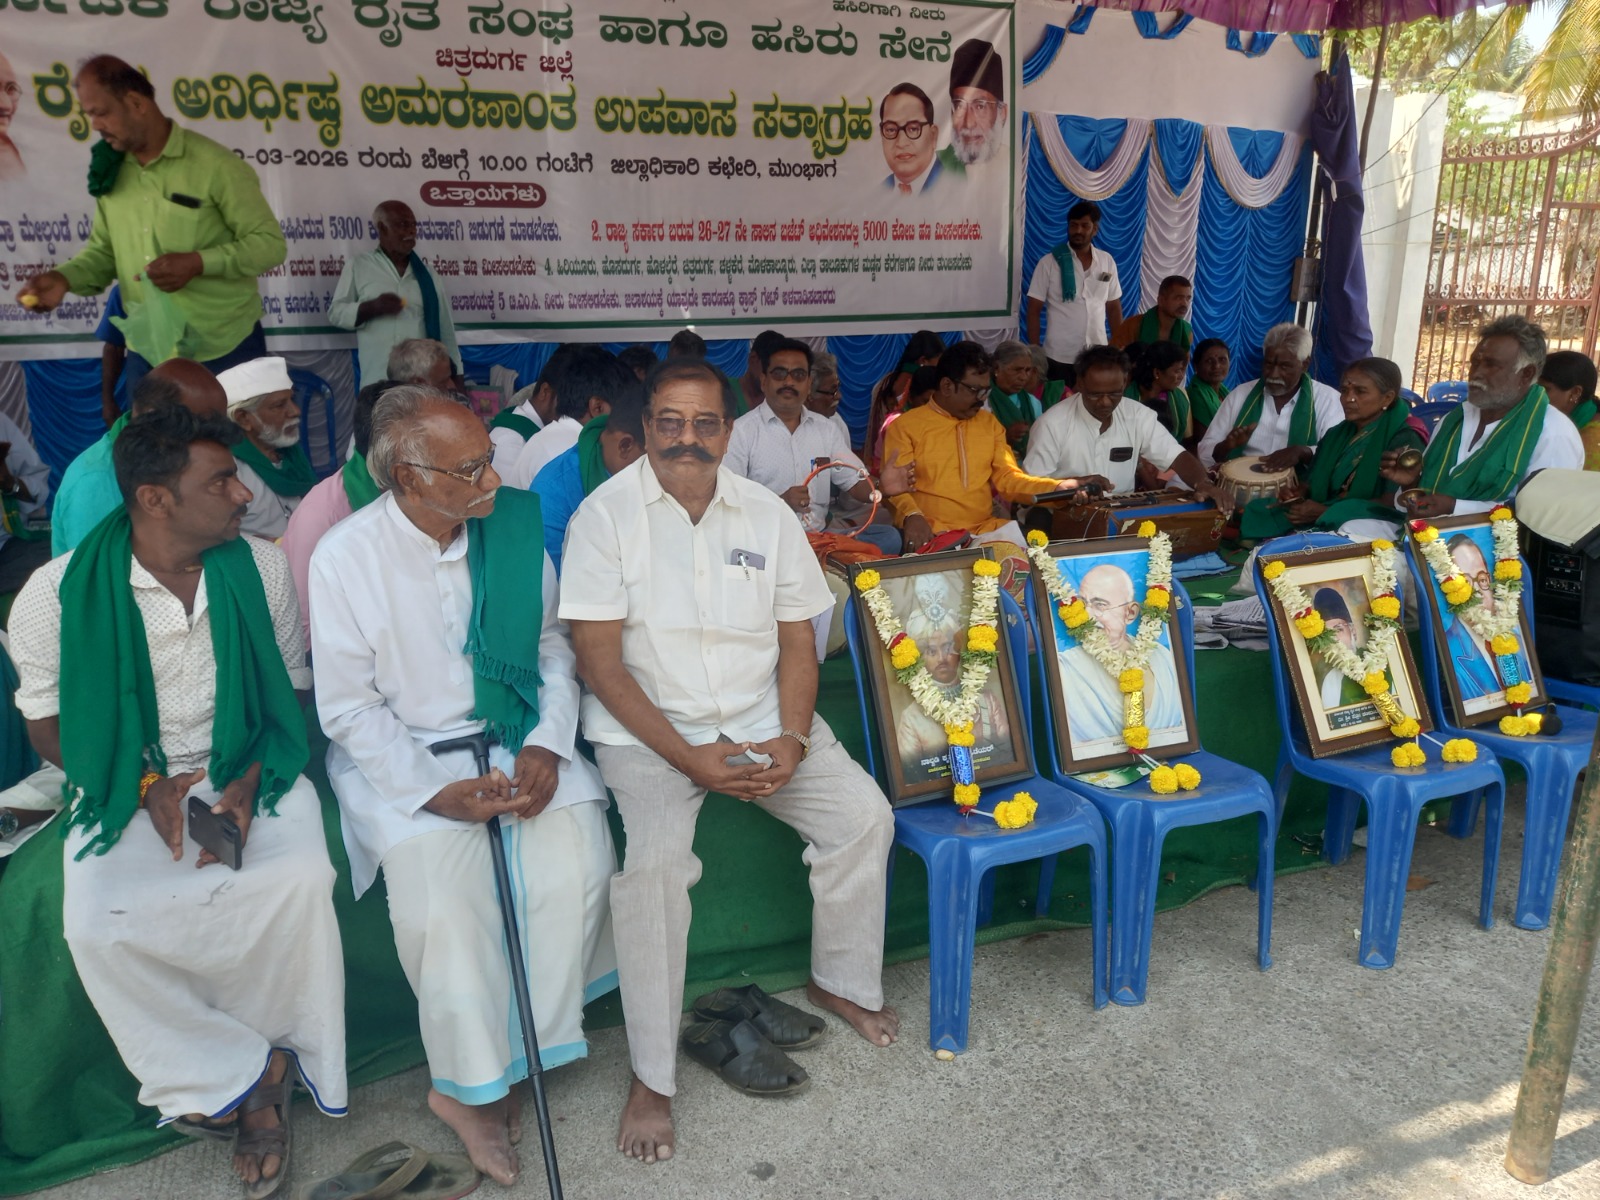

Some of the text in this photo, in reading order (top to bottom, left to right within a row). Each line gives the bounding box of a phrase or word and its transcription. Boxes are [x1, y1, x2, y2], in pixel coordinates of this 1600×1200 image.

[909, 6, 945, 20] ನೀರು
[354, 0, 441, 47] ರೈತ
[469, 2, 573, 45] ಸಂಘ
[599, 11, 728, 48] ಹಾಗೂ
[751, 19, 858, 57] ಹಸಿರು
[879, 26, 952, 63] ಸೇನೆ
[435, 47, 575, 82] ಚಿತ್ರದುರ್ಗ ಜಿಲ್ಲೆ
[361, 76, 577, 134] ಅಮರಣಾಂತ
[594, 87, 738, 142] ಉಪವಾಸ
[752, 93, 874, 160] ಸತ್ಯಾಗ್ರಹ
[232, 147, 349, 167] -03-2026
[357, 146, 412, 169] ರಂದು
[421, 147, 470, 181] ಬೆಳಿಗ್ಗೆ
[479, 155, 528, 172] 10.00
[536, 152, 594, 173] ಗಂಟೆಗೆ
[611, 157, 700, 182] ಜಿಲ್ಲಾಧಿಕಾರಿ
[329, 215, 363, 241] 5300
[698, 219, 731, 242] 26-27
[862, 220, 888, 241] 5000
[498, 291, 506, 311] 5
